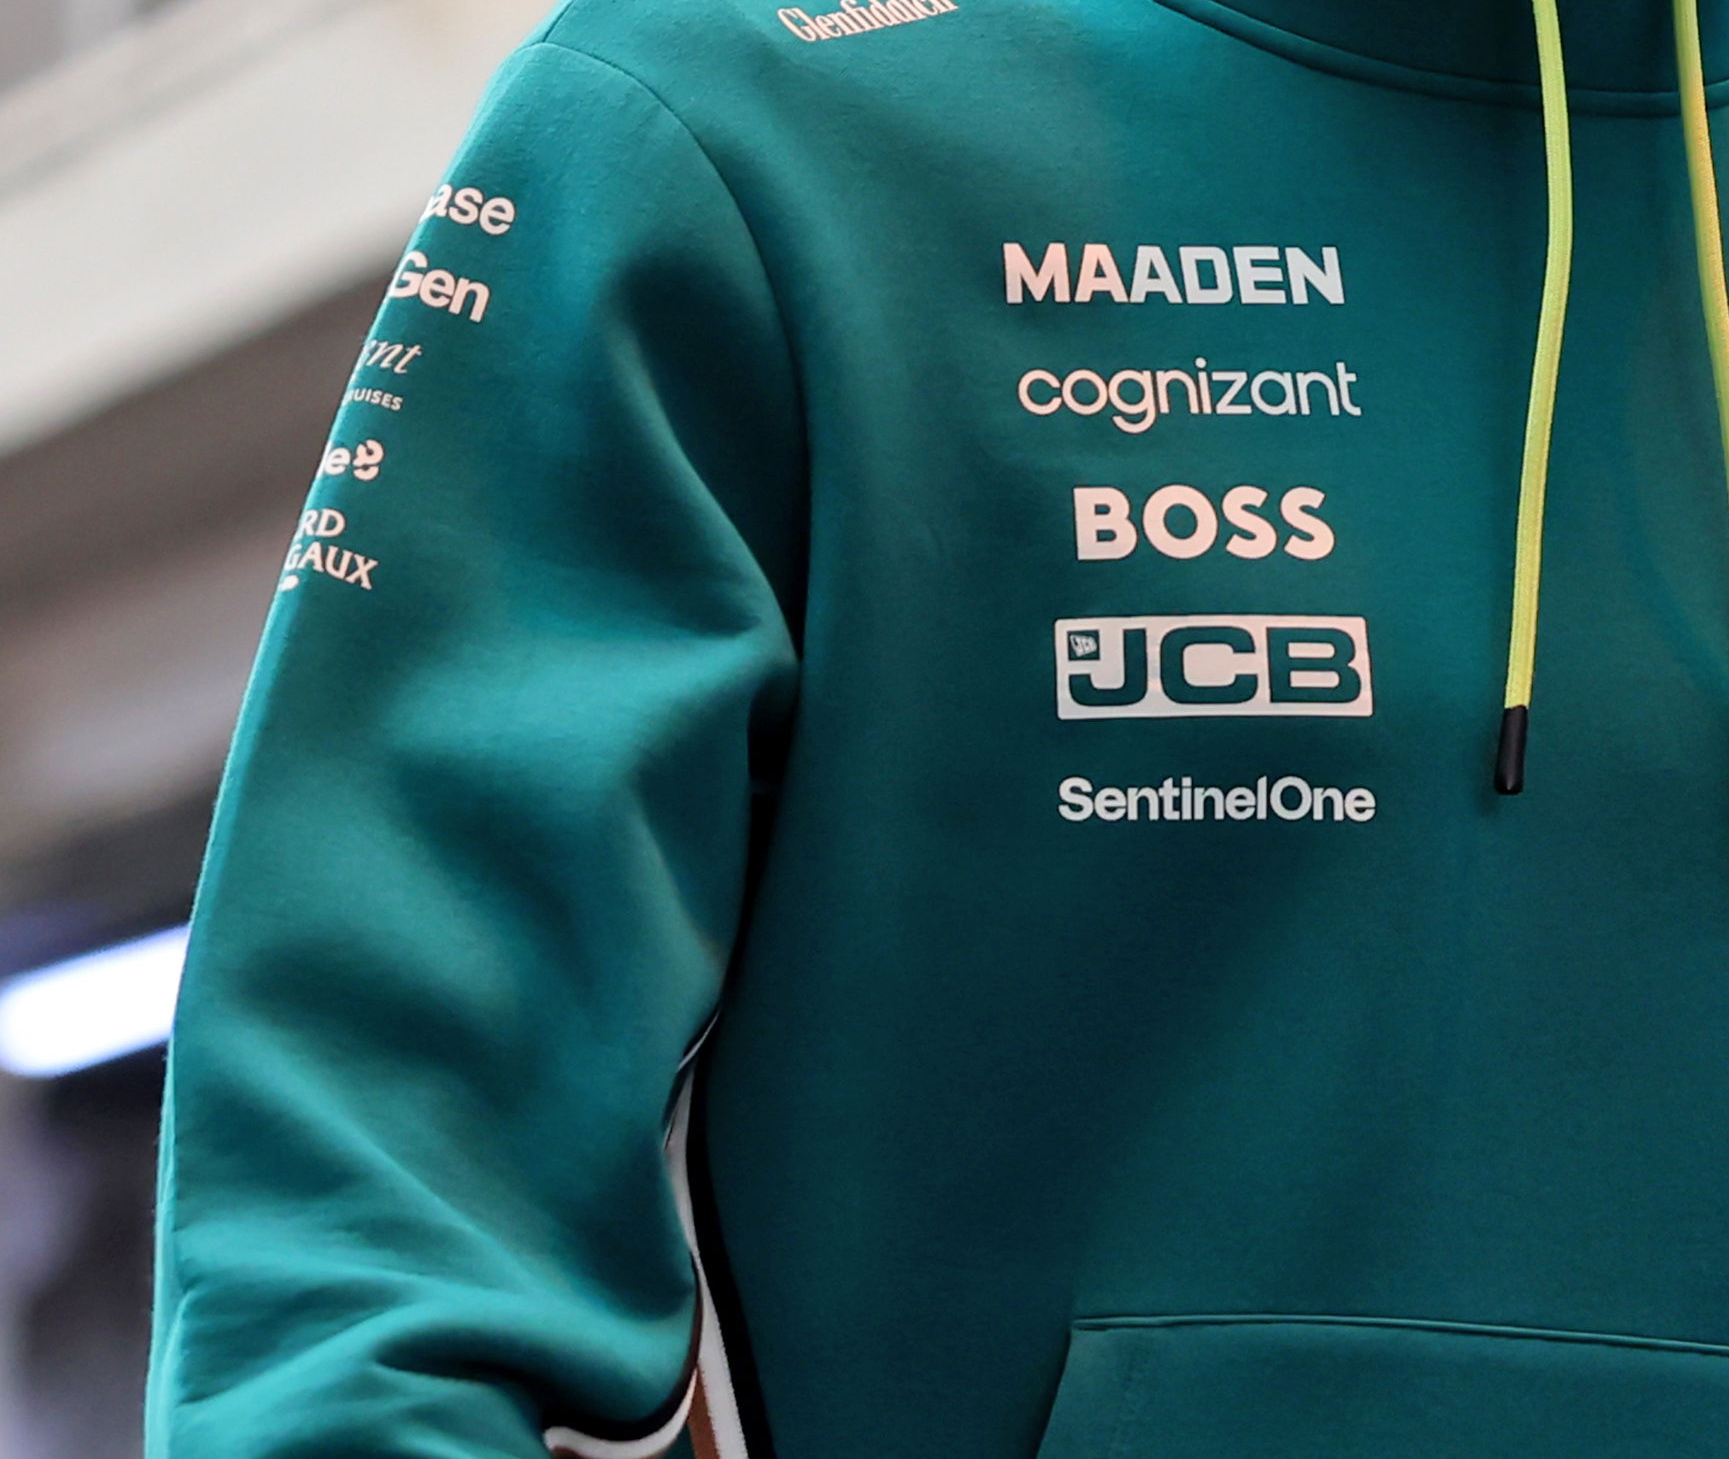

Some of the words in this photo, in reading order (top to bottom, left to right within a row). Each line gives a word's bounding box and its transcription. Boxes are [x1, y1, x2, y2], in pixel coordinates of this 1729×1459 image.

[1002, 242, 1346, 305] MAADEN
[1018, 358, 1362, 434] cognizant
[1073, 484, 1336, 561] BOSS
[1067, 625, 1363, 708] JCB
[1058, 774, 1377, 823] SentinelOne
